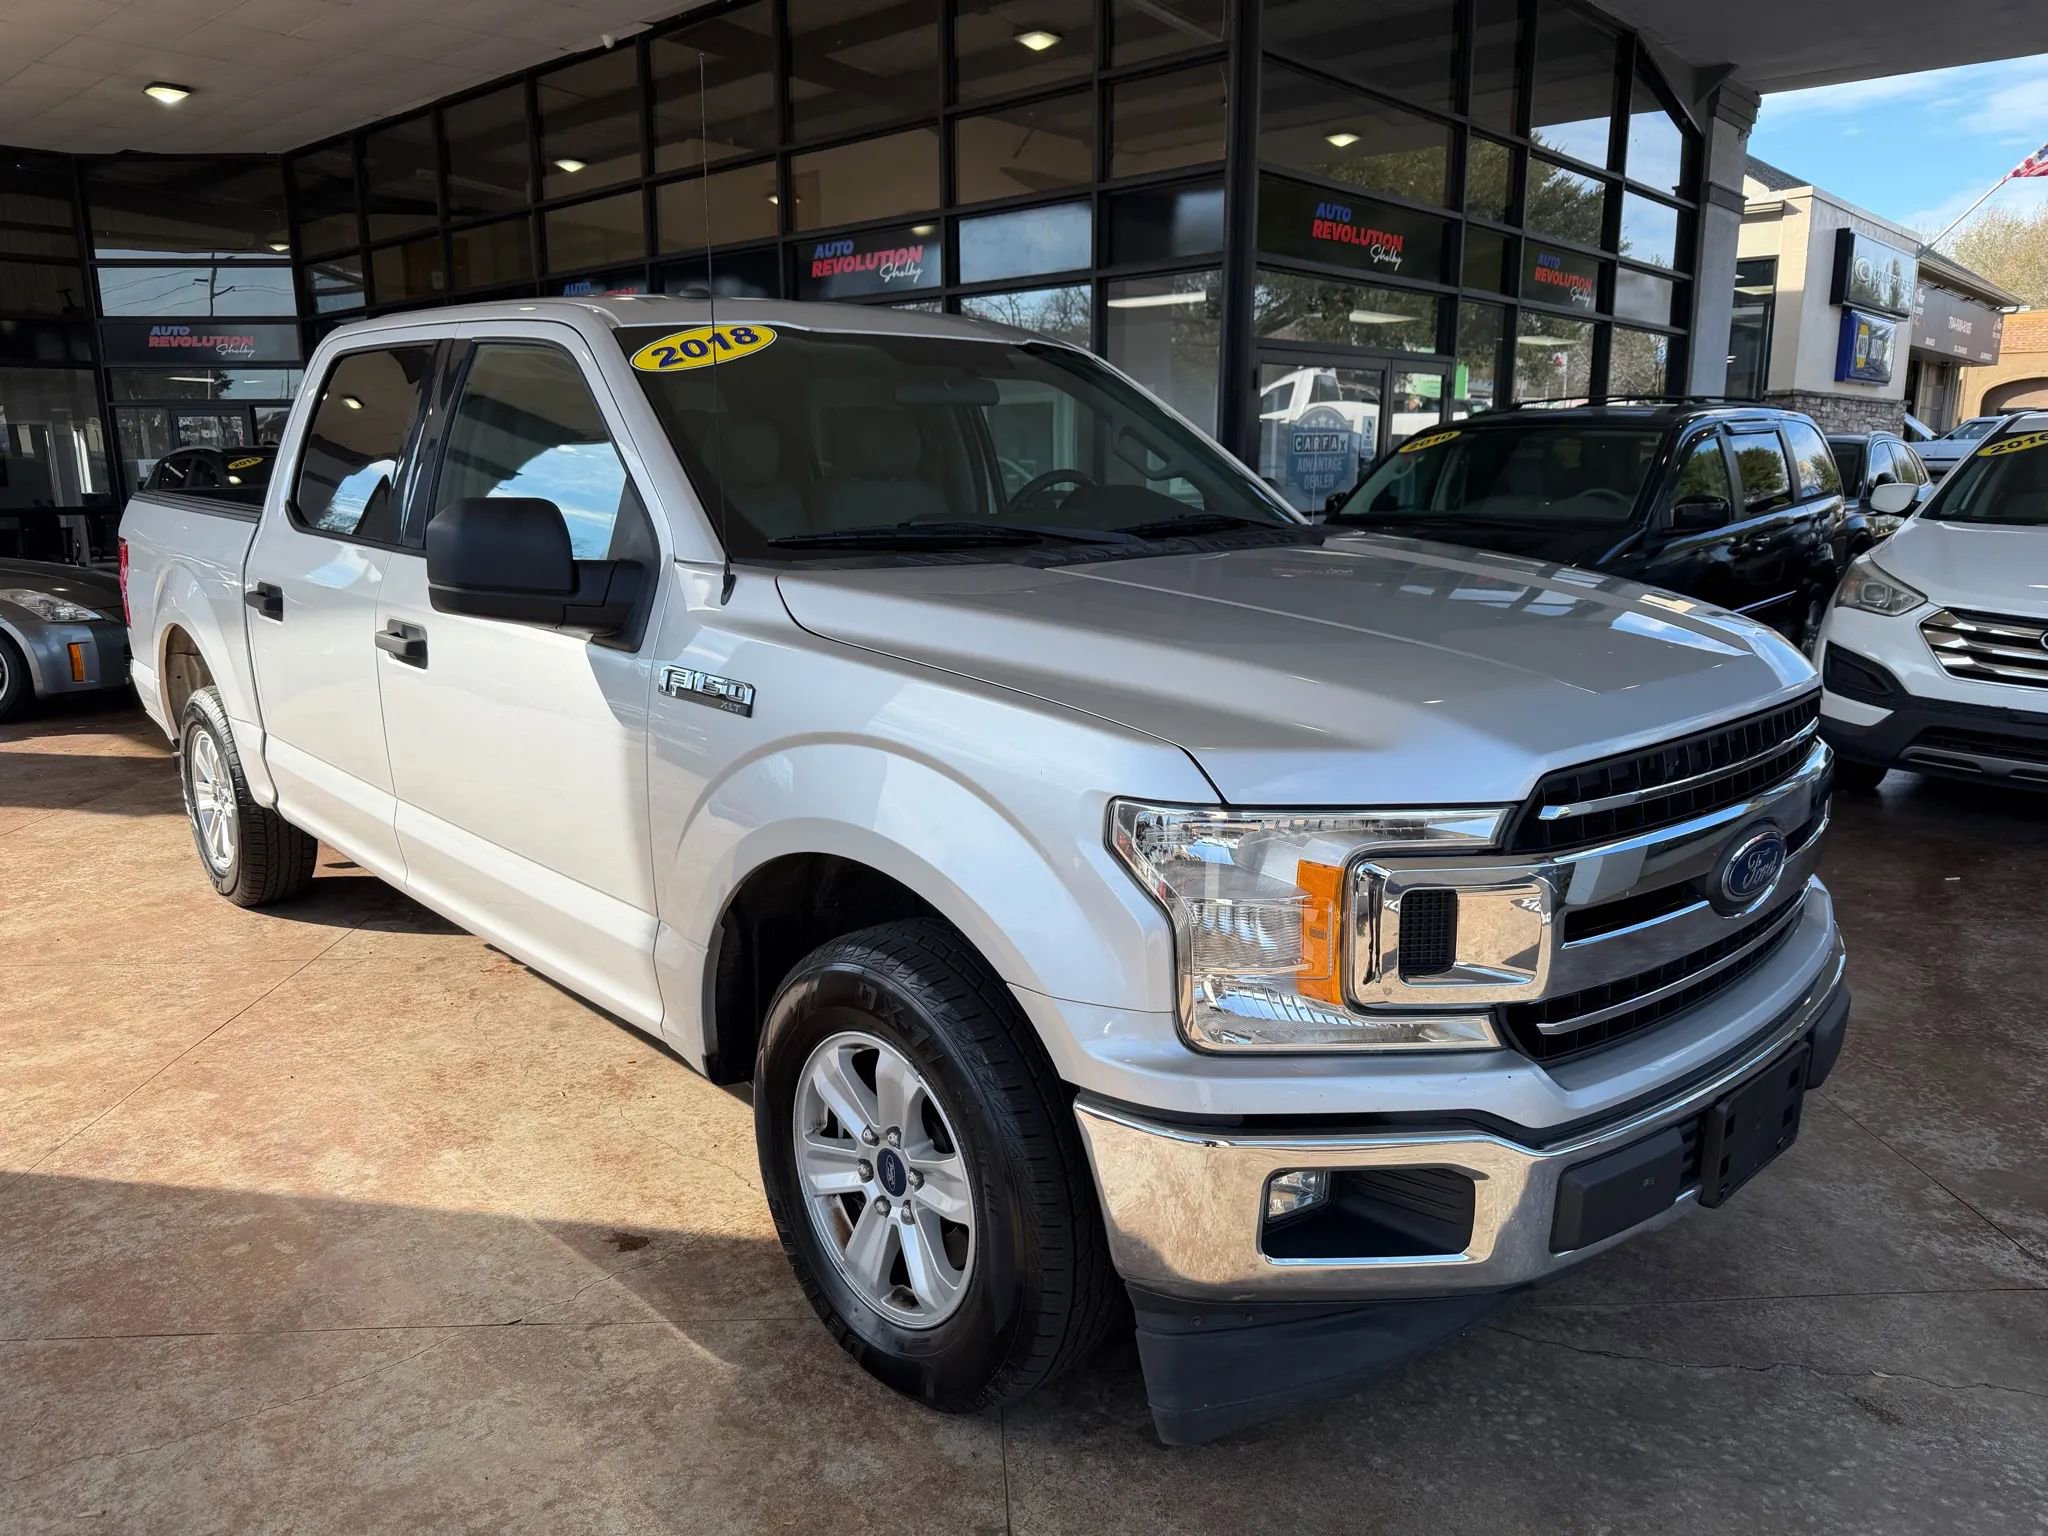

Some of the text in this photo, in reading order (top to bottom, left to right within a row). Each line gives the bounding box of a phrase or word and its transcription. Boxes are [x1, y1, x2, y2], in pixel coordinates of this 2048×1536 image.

[1315, 202, 1352, 222] AUTO
[1312, 219, 1404, 251] REVOLUTION
[814, 240, 854, 259] AUTO
[1370, 243, 1402, 271] Shelby
[812, 246, 923, 278] REVOLUTION
[879, 259, 924, 283] Shelby
[1536, 253, 1561, 270] AUTO
[1535, 266, 1593, 290] REVOLUTION
[150, 325, 190, 336] AUTO
[148, 335, 255, 348] REVOLUTION
[215, 343, 256, 358] Shelby
[651, 326, 761, 368] 2018
[1295, 434, 1347, 453] CARFAX
[1296, 456, 1345, 473] ADVANTAGE
[1304, 474, 1335, 490] DEALER
[720, 700, 741, 713] XLT
[1742, 847, 1779, 890] Ford
